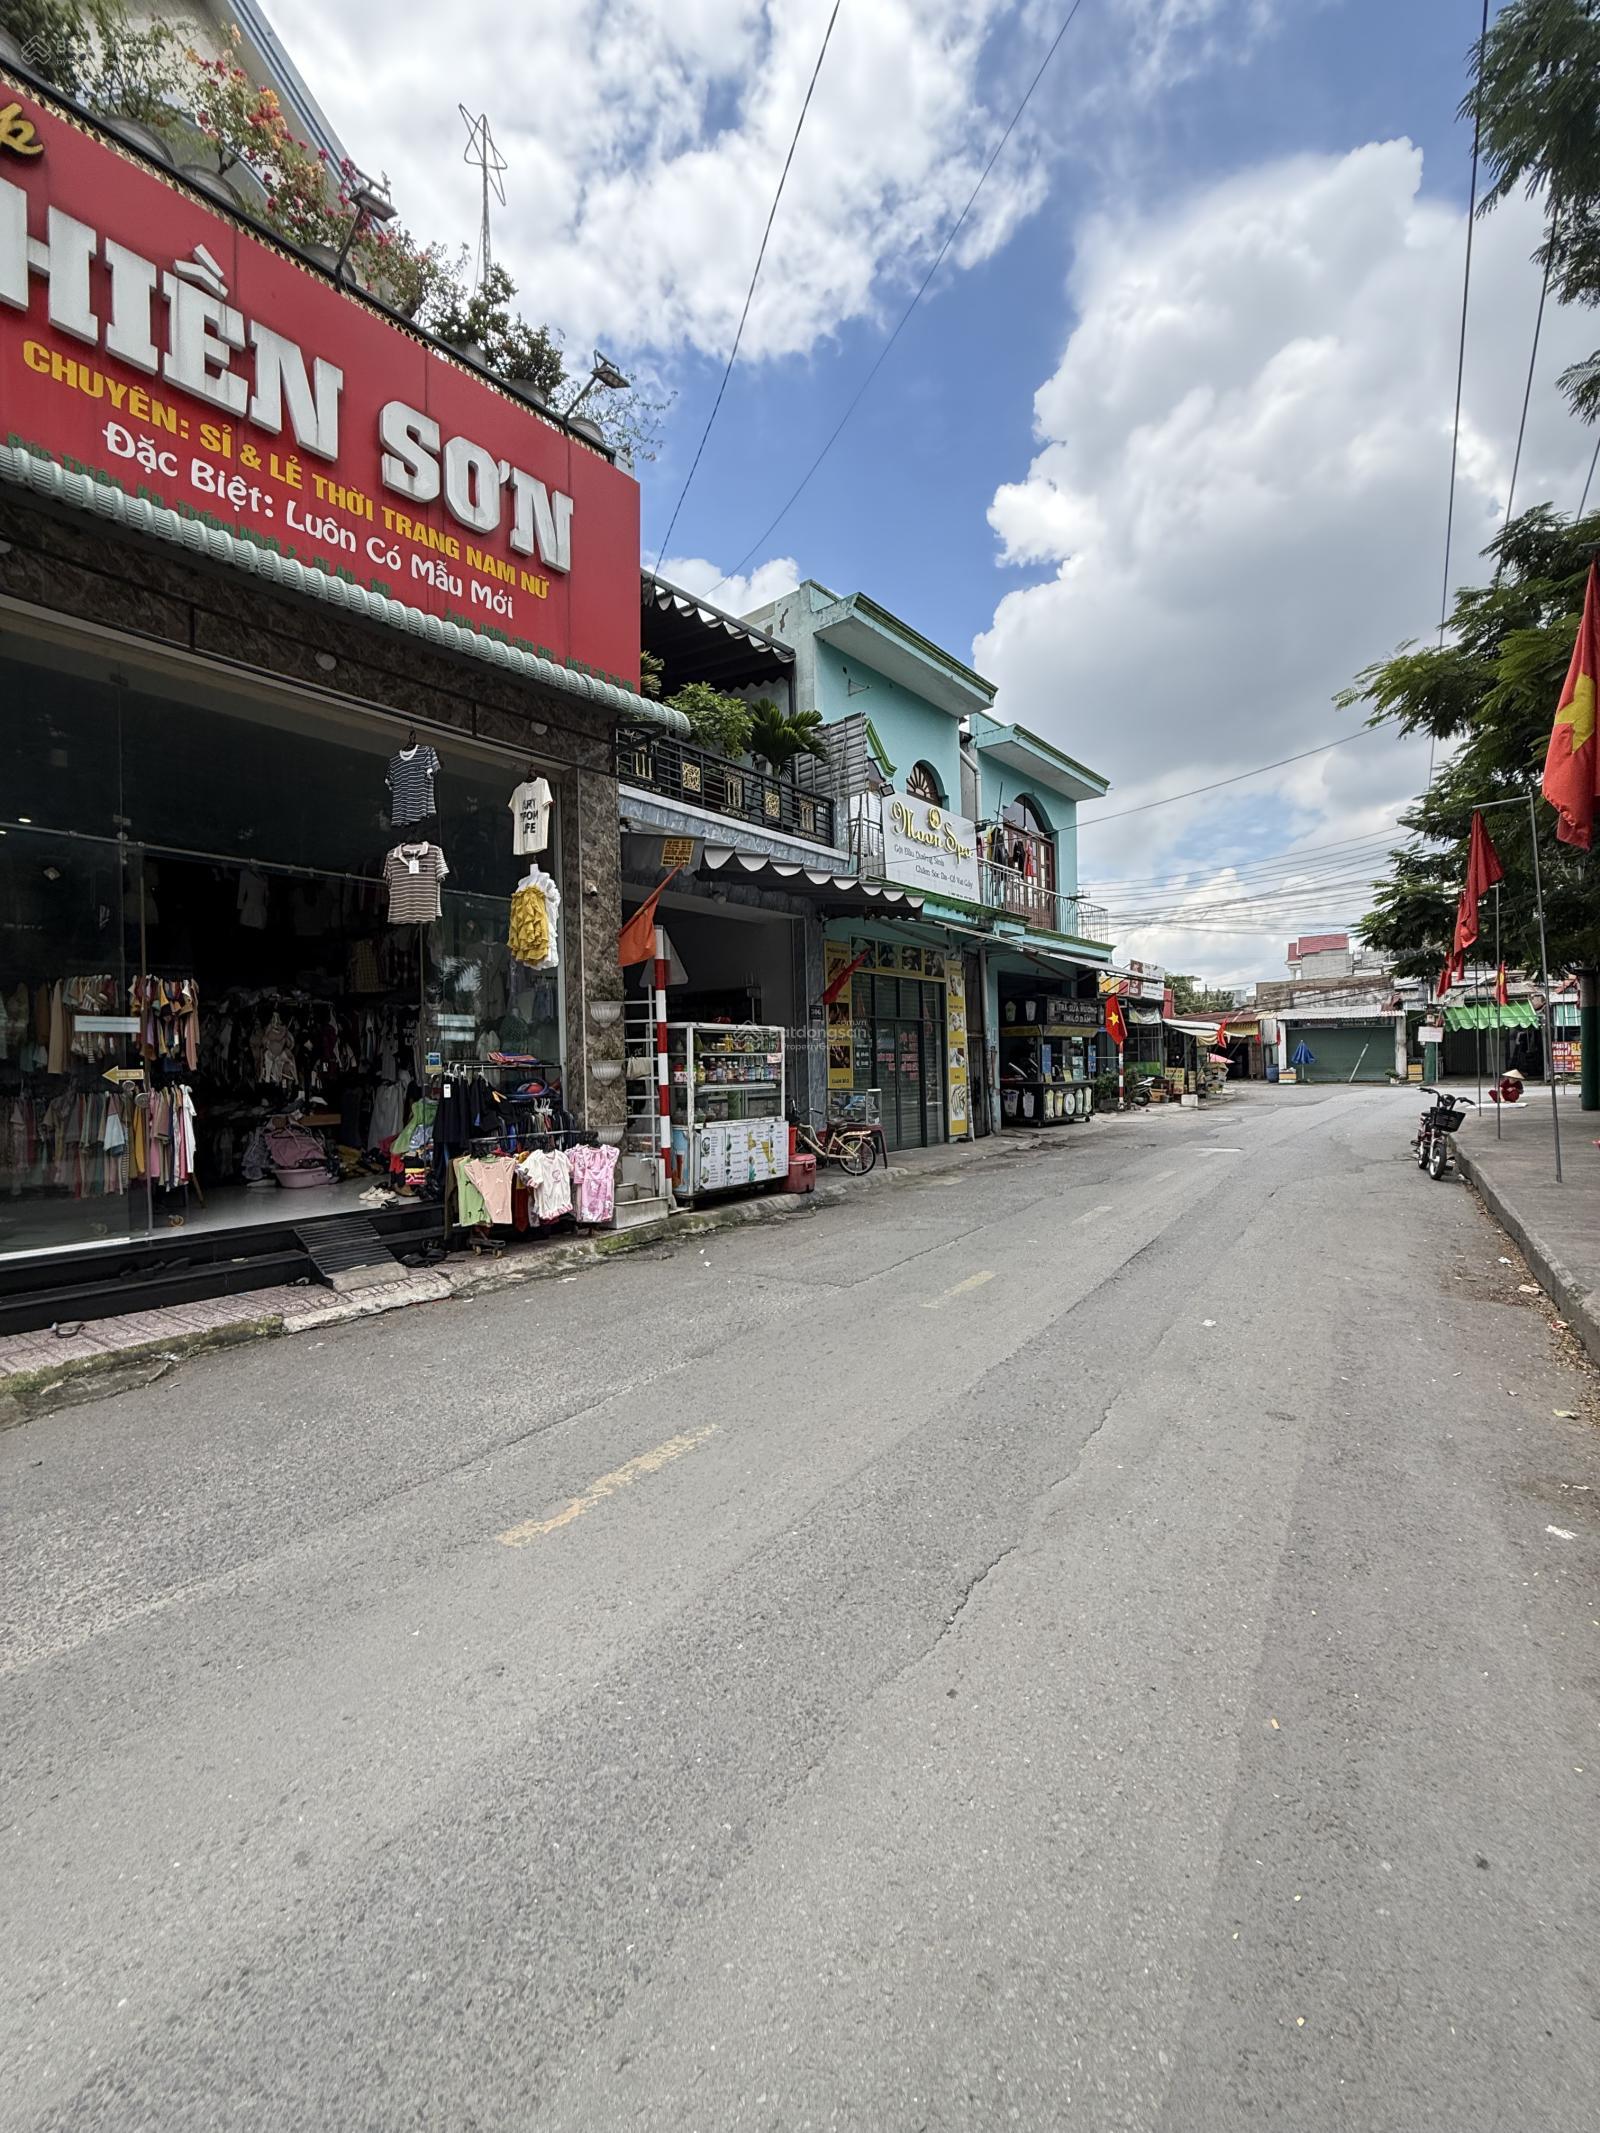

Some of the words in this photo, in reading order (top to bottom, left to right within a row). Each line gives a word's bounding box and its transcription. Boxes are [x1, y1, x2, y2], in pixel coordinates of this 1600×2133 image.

[23, 340, 189, 440] CHUYÊN:
[200, 423, 232, 459] SỈ
[240, 444, 262, 471] &
[270, 455, 303, 490] LẺ
[312, 472, 373, 521] THỜI
[381, 505, 459, 561] TRANG
[466, 545, 516, 586] NAM
[521, 570, 549, 600] NỮ
[102, 421, 178, 477] Đặc
[191, 457, 274, 519] Biệt:
[286, 499, 356, 553] Luôn
[366, 535, 401, 571] Có
[411, 553, 463, 598] Mẫu
[471, 579, 514, 620] Mới
[380, 400, 574, 575] SƠN
[890, 800, 944, 849] Moon
[944, 821, 974, 865] Spa
